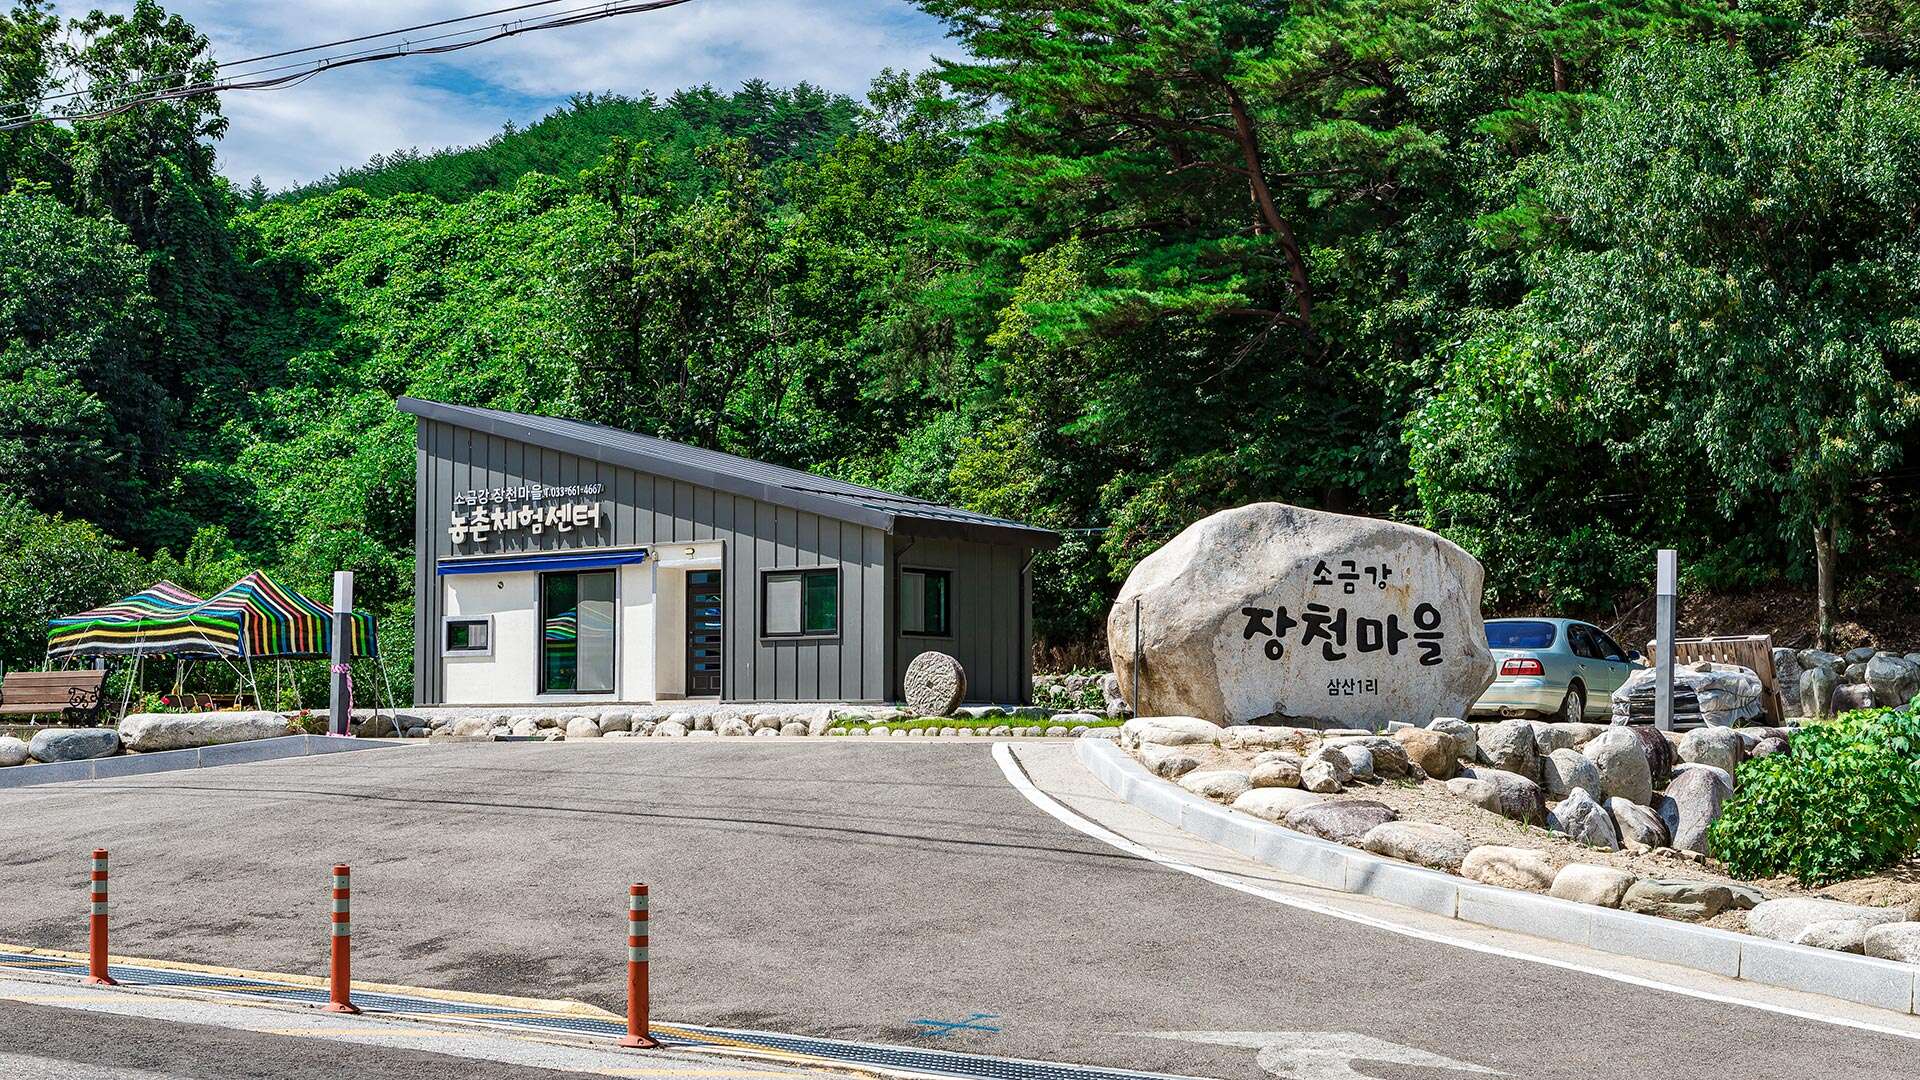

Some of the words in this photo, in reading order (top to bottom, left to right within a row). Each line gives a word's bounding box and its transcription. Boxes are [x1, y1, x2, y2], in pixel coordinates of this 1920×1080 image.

[453, 489, 489, 506] 소금강
[491, 484, 542, 503] 장천마을
[1312, 560, 1392, 594] 소금강
[1241, 602, 1444, 666] 장천마을
[1326, 678, 1378, 696] 삼산1리
